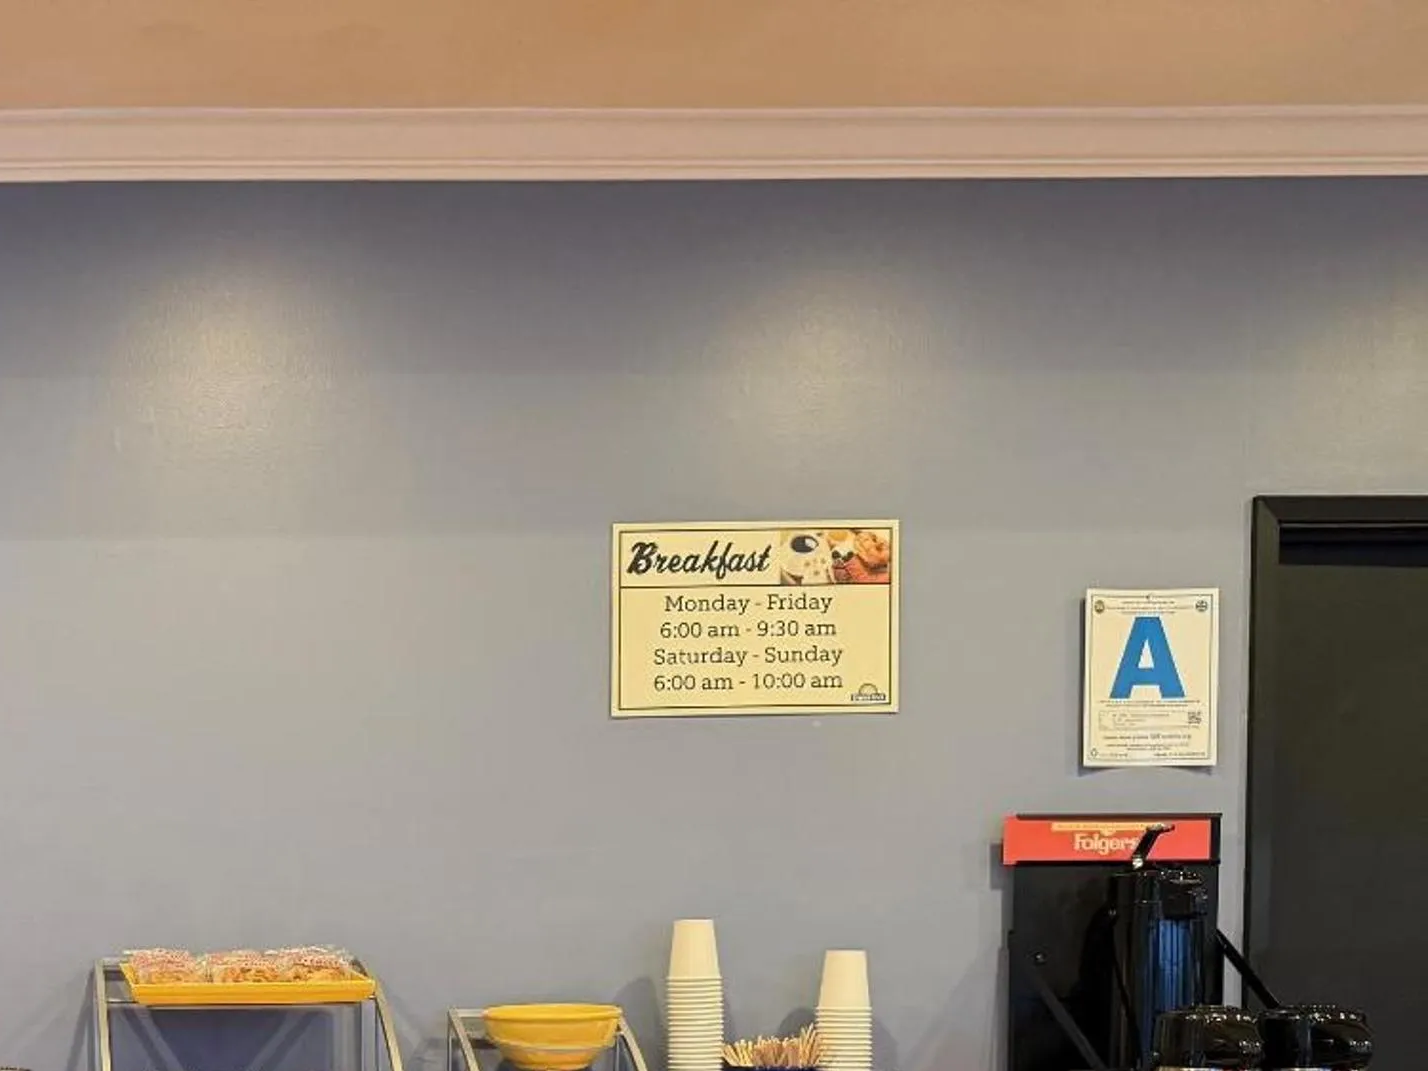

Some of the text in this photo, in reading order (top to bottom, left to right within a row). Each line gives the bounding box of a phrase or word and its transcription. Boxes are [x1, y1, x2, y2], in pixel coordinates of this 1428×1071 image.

[627, 540, 771, 580] Breakfast
[664, 594, 750, 616] Monday
[767, 593, 833, 614] Friday
[660, 621, 702, 639] 6:00
[707, 625, 740, 637] am
[757, 620, 799, 637] 9:30
[804, 624, 836, 636] am
[654, 647, 748, 667] Saturday
[764, 645, 843, 666] Sunday
[1109, 616, 1186, 699] A
[654, 674, 696, 692] 6:00
[702, 678, 734, 691] am
[752, 672, 806, 690] 10:00
[810, 677, 843, 689] am
[1074, 833, 1140, 855] Folgers
